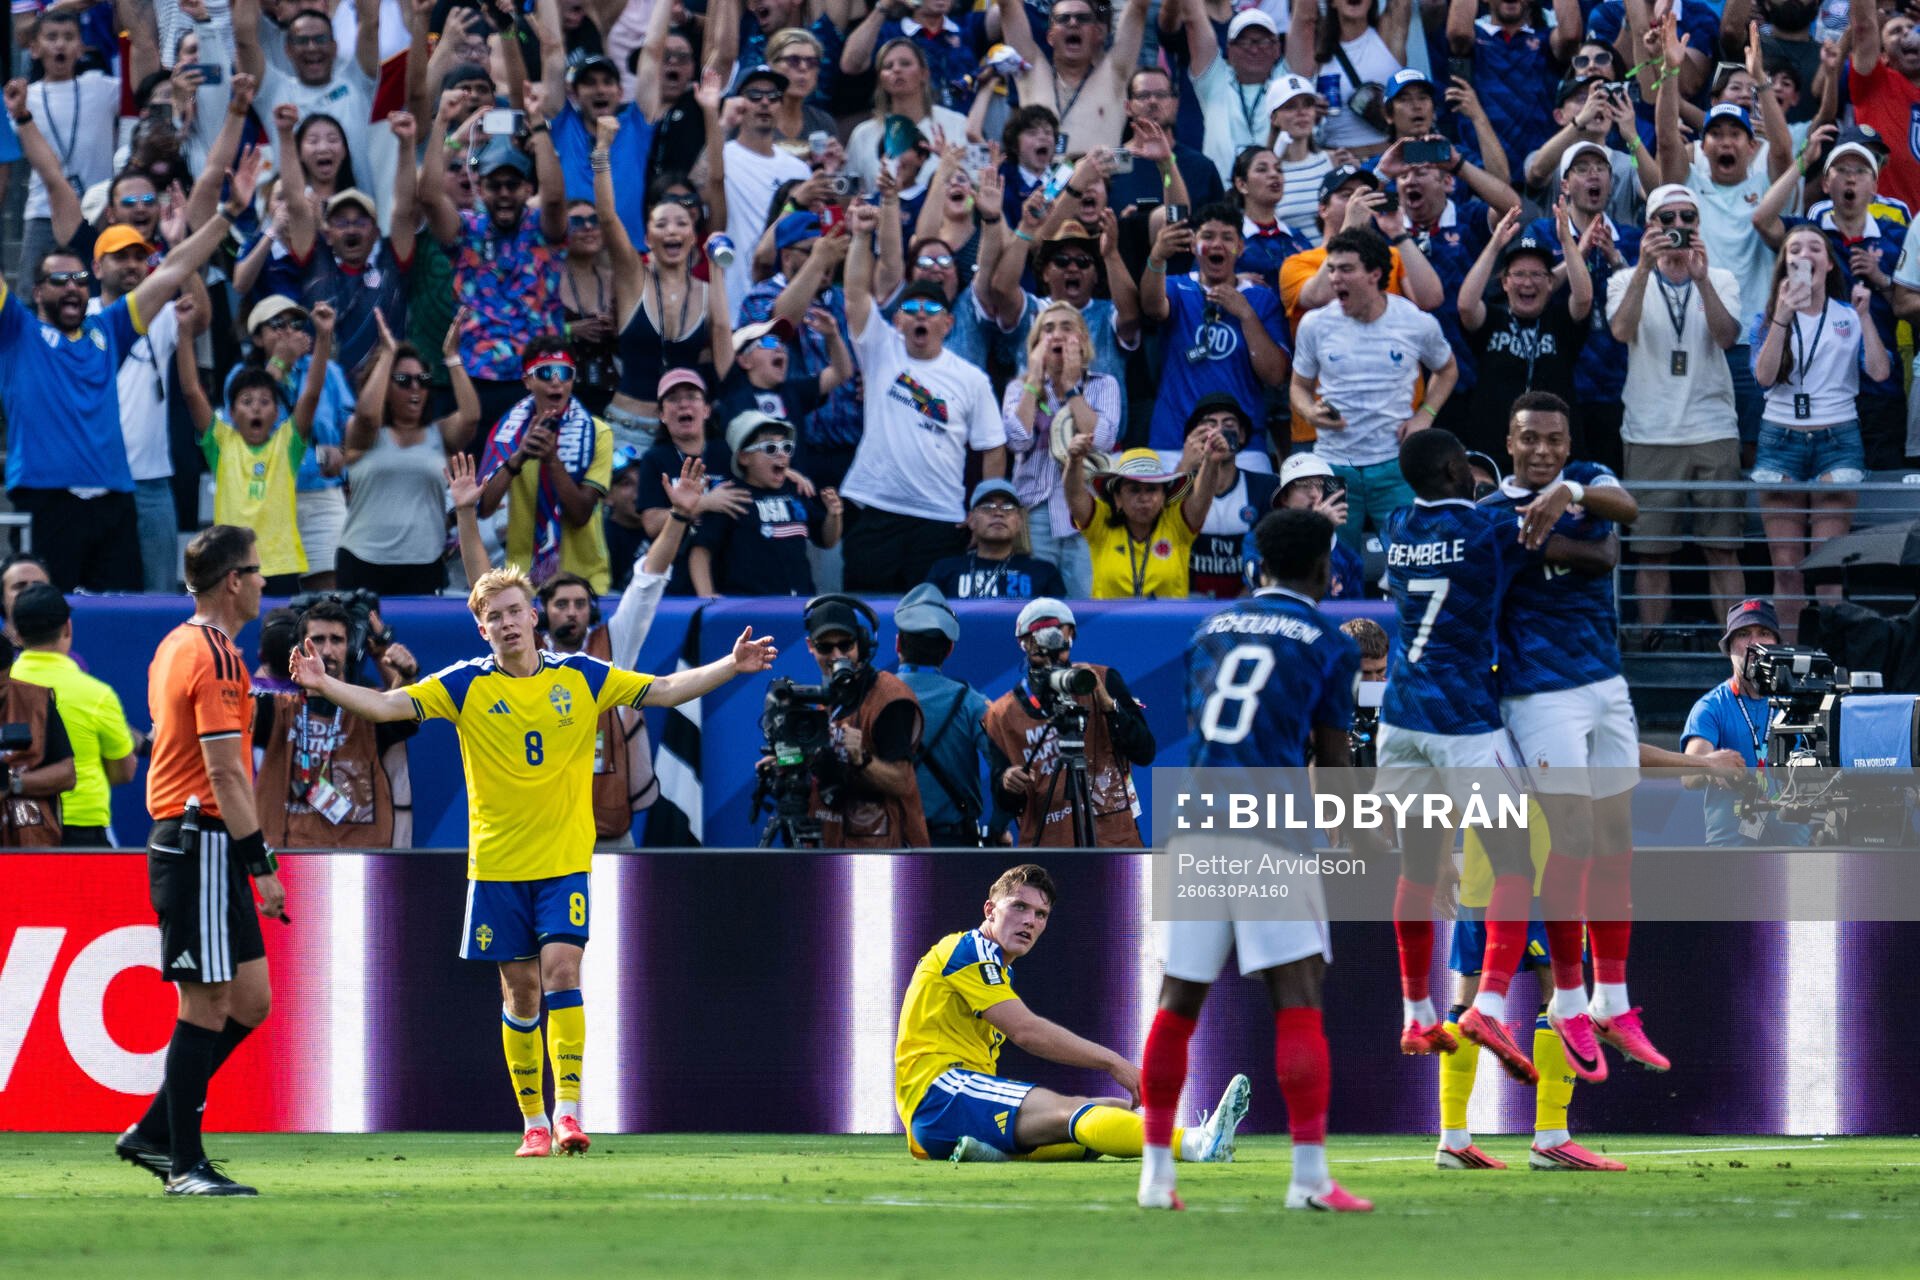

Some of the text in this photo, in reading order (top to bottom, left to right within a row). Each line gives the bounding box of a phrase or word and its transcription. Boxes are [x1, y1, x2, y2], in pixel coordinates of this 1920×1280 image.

[1006, 572, 1031, 597] 26
[1407, 578, 1449, 663] 7
[1201, 644, 1275, 744] 8
[525, 730, 544, 766] 8
[569, 892, 586, 927] 8
